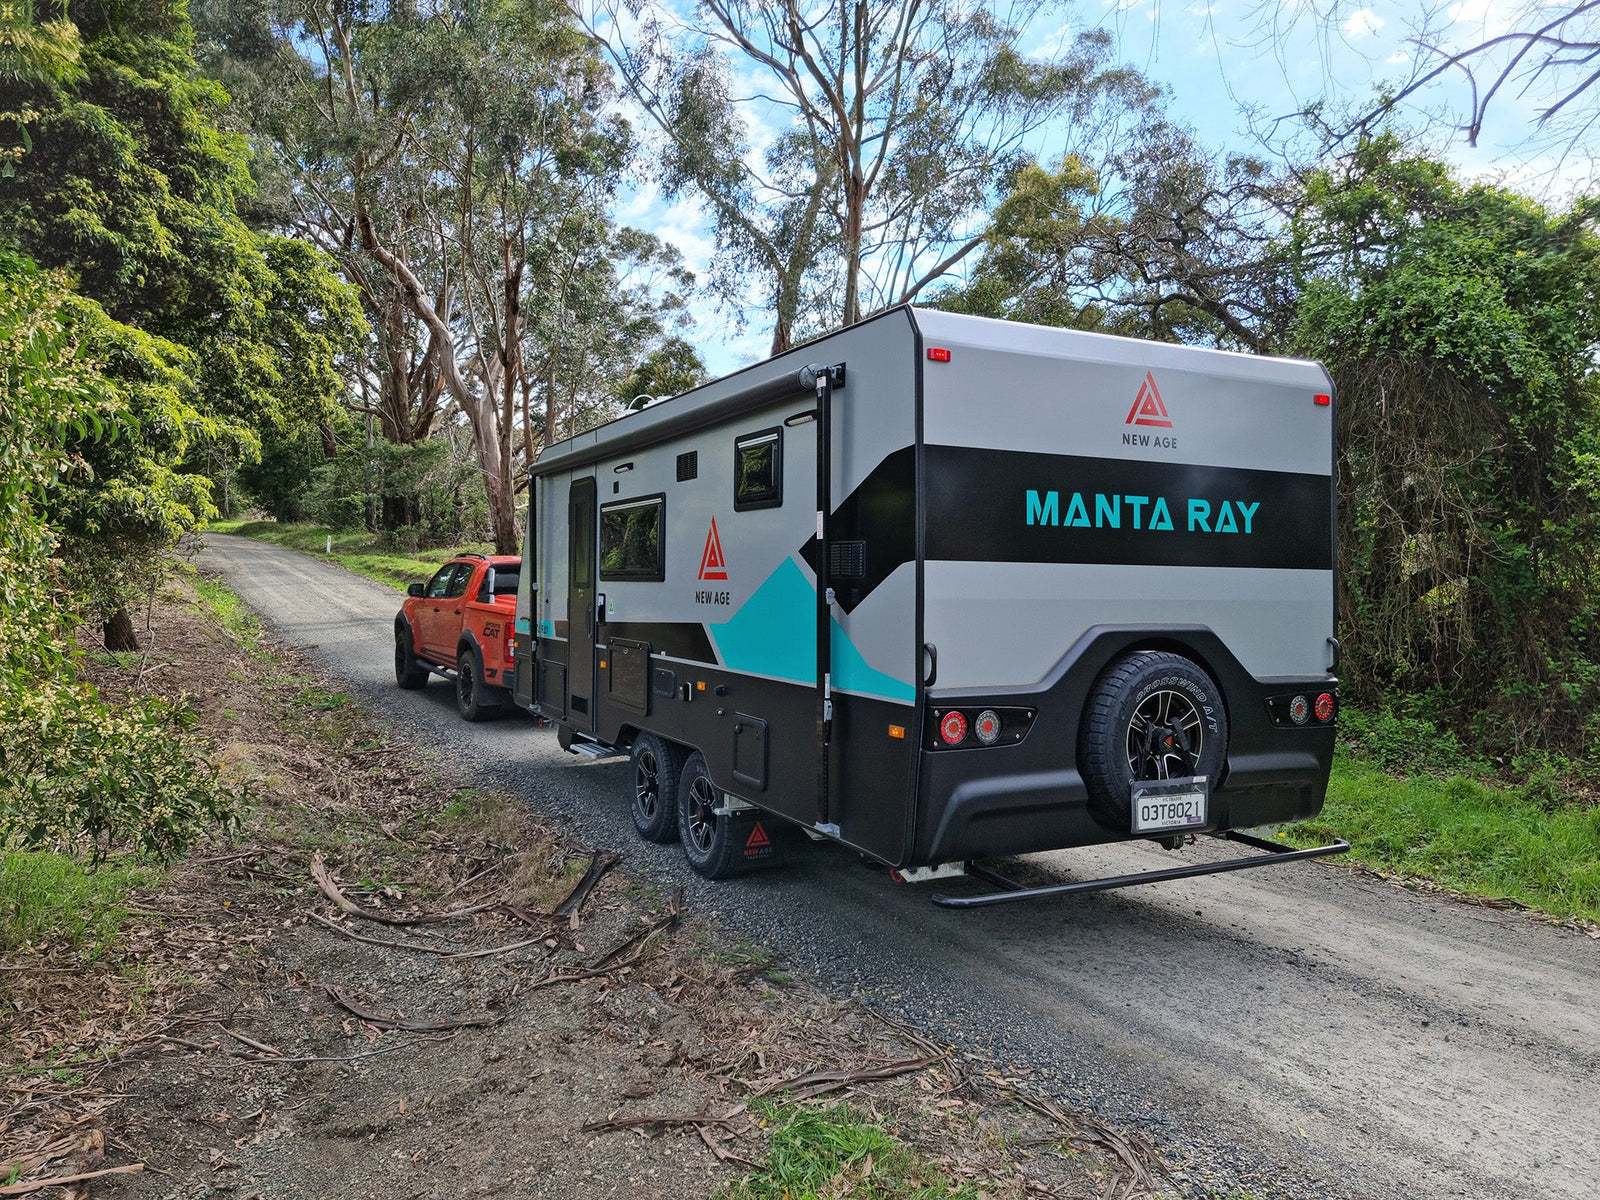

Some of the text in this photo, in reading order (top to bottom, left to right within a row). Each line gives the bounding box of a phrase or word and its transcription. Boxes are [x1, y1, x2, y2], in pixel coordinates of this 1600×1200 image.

[1122, 433, 1177, 449] NEW AGE
[1025, 489, 1261, 534] MANTA RAY
[695, 591, 730, 605] NEW AGE
[482, 627, 500, 639] CAT
[1136, 676, 1219, 734] CROSSWIND A/T
[1141, 800, 1199, 822] 03T8021
[743, 848, 759, 857] NEW
